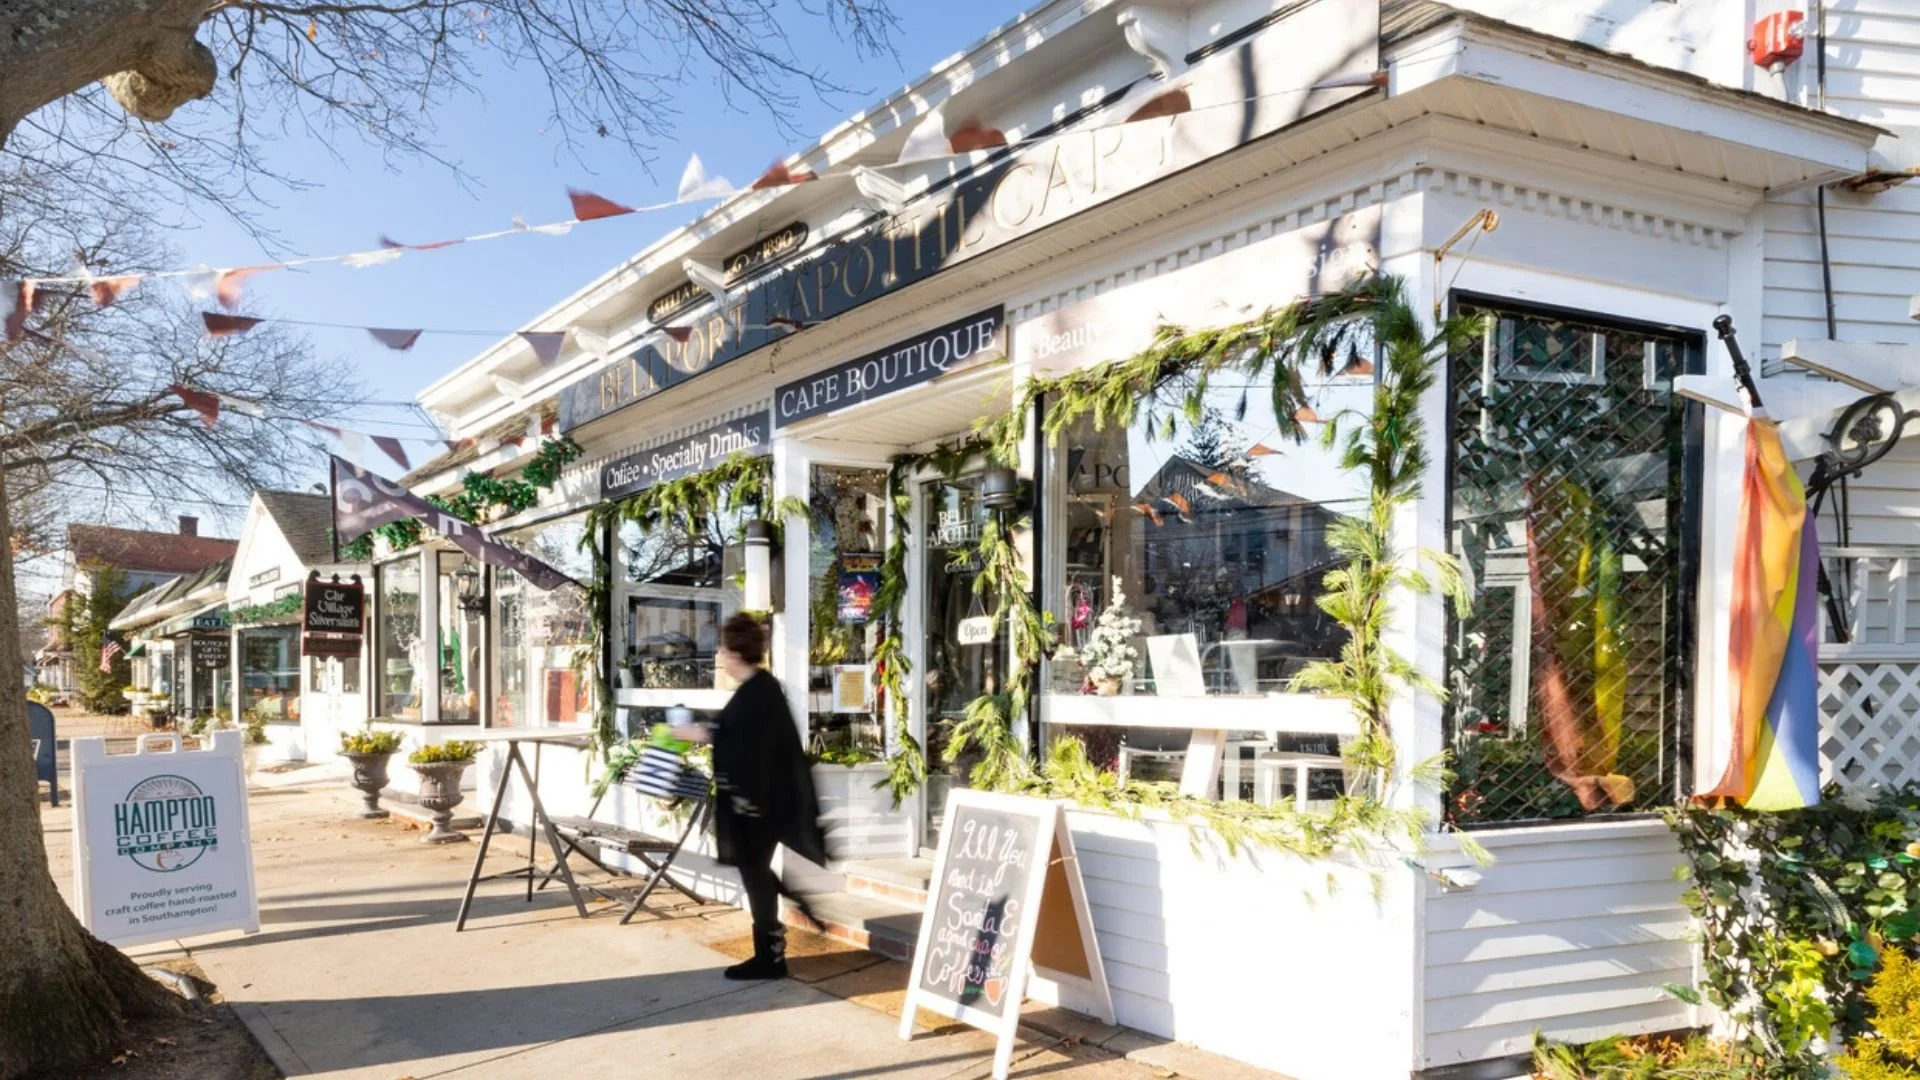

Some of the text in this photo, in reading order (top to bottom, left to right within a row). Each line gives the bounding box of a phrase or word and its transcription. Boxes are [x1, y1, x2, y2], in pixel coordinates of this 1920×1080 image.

[600, 303, 751, 411] BELLPORT
[781, 318, 996, 418] CAFE BOUTIQUE
[607, 423, 760, 489] Coffee Specialty Drinks
[324, 588, 345, 601] The
[308, 611, 360, 627] Silversmith
[316, 600, 354, 618] Village
[963, 623, 988, 641] Open
[115, 796, 216, 836] HAMPTON
[117, 828, 217, 847] COFFEE
[956, 819, 1027, 886] All You
[131, 882, 213, 901] Proudly serving
[976, 874, 995, 897] is
[105, 890, 237, 916] craft coffee hand-roasted
[129, 905, 218, 924] in Southampton!
[948, 891, 998, 933] Santa
[927, 947, 984, 995] Coffee
